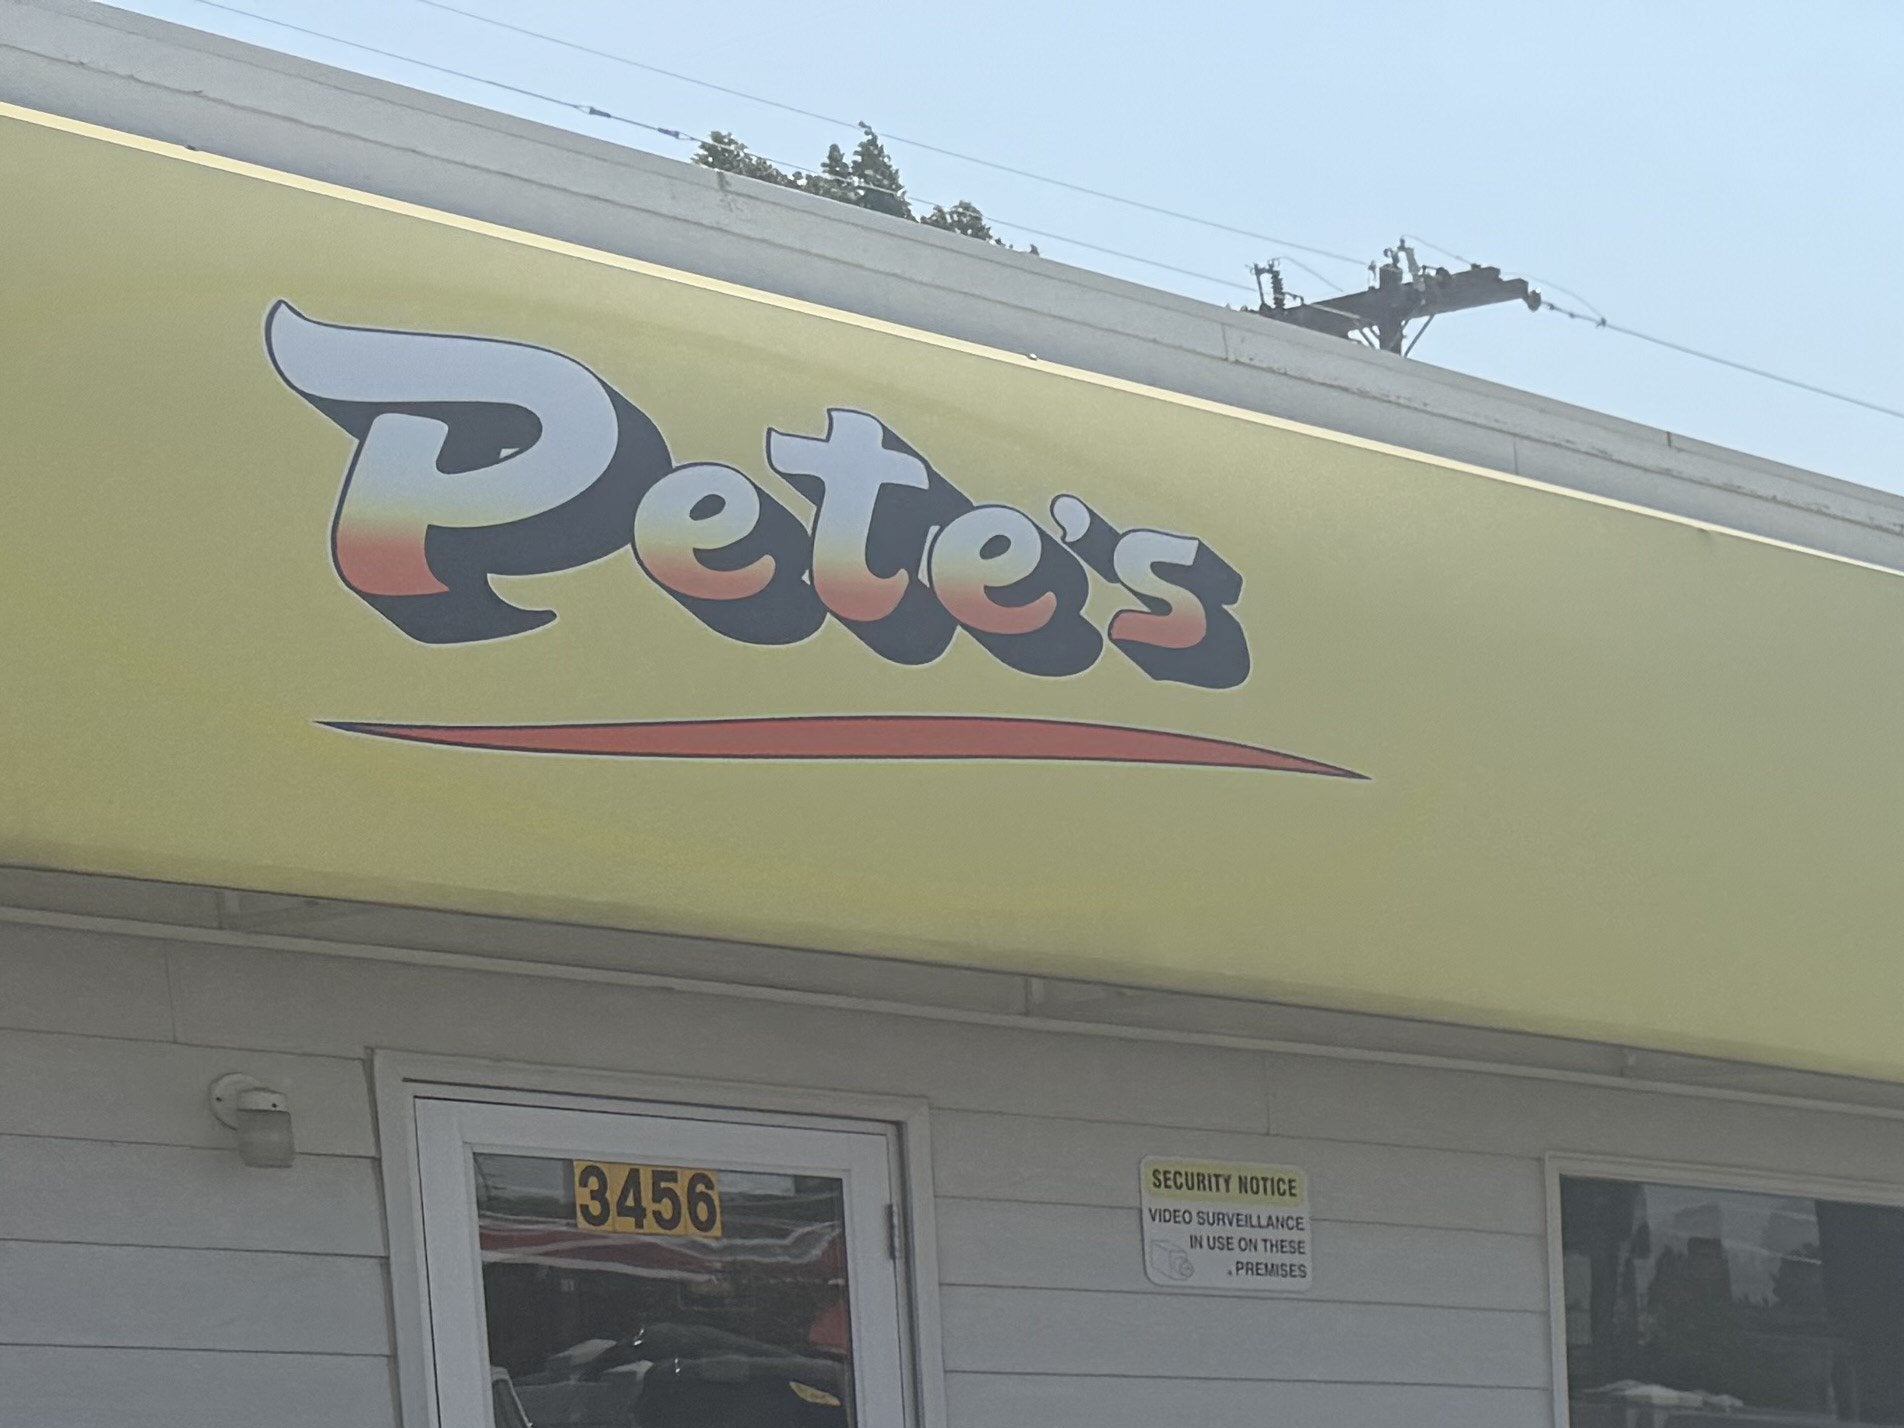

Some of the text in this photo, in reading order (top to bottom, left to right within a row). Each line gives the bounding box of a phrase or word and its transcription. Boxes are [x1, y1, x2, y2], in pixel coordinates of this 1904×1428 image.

[265, 299, 1250, 690] Pete's
[1152, 1168, 1297, 1197] SECURITY NOTICE
[577, 1164, 718, 1233] 3456
[1149, 1208, 1305, 1231] VIDEO SURVEILLANCE
[1190, 1234, 1305, 1255] IN USE ON THESE
[1235, 1261, 1307, 1278] PREMISES
